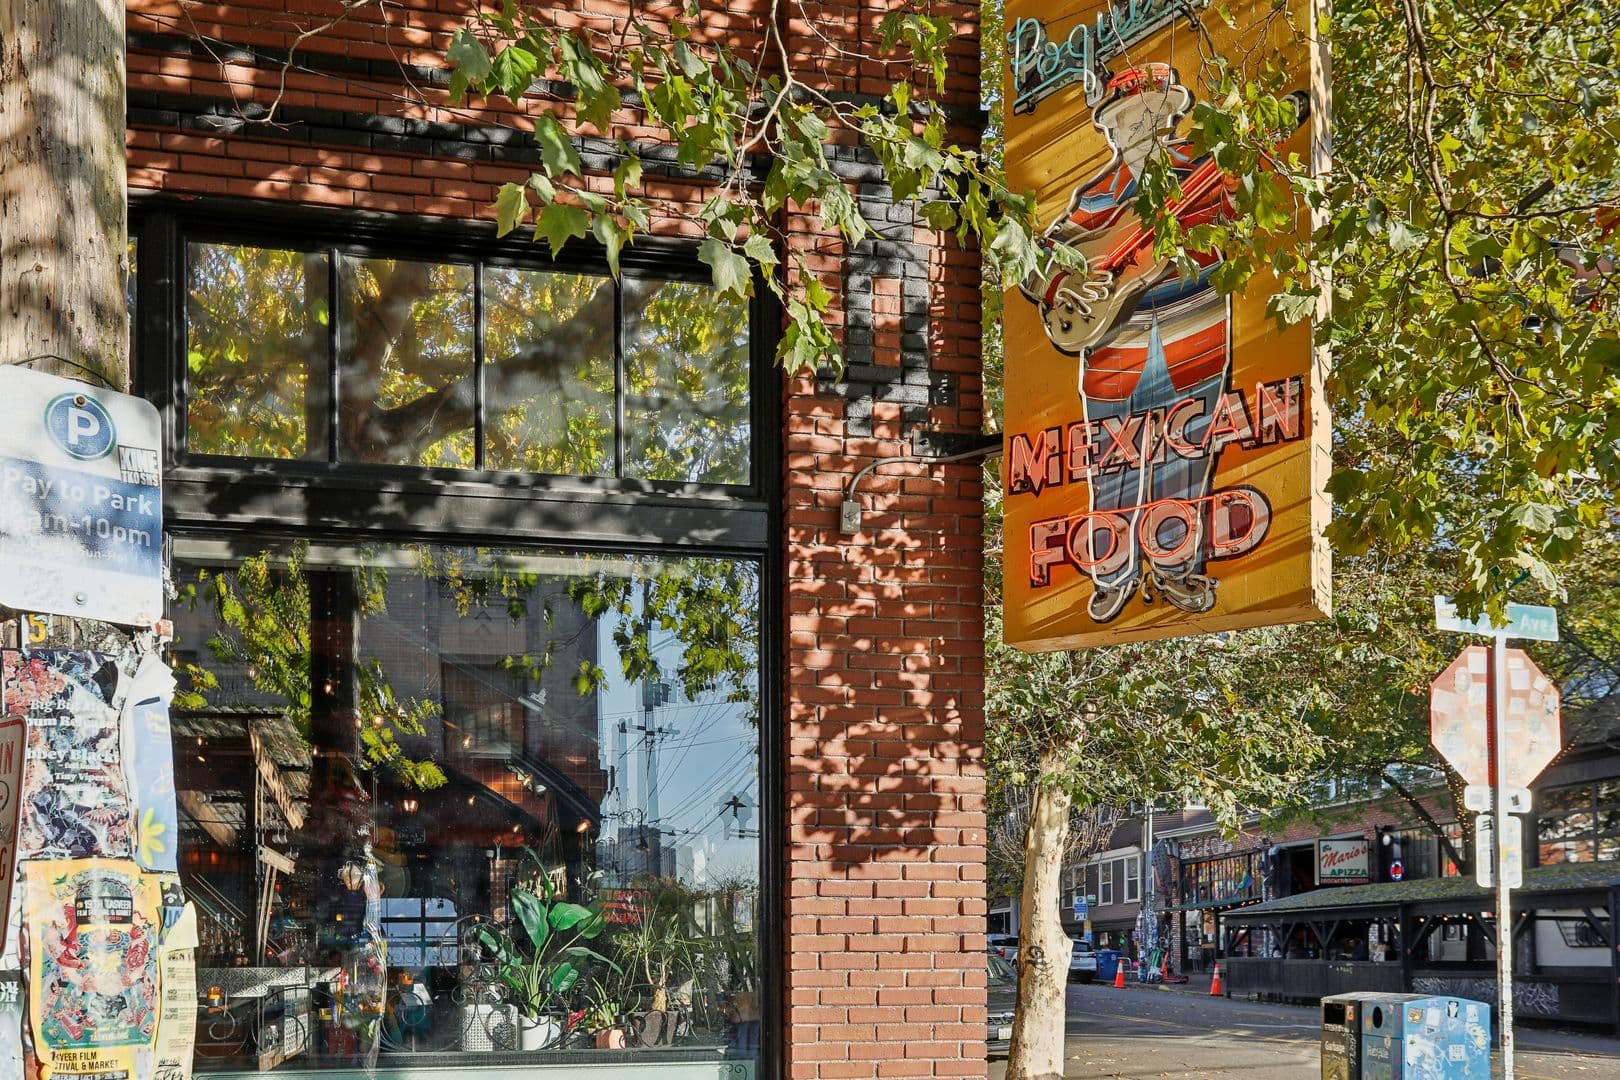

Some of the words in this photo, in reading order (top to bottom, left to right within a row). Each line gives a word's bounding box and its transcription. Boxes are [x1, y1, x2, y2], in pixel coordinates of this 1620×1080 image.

[67, 407, 100, 445] P
[1009, 377, 1304, 496] MEXICAN
[4, 467, 52, 499] Pay
[60, 480, 84, 502] to
[94, 485, 153, 516] Park
[1029, 485, 1272, 588] FOOD
[29, 613, 47, 643] 5
[1520, 613, 1551, 632] Ave
[1320, 844, 1369, 868] Mario's
[1330, 868, 1367, 877] APIZZA
[79, 1051, 97, 1060] FILM
